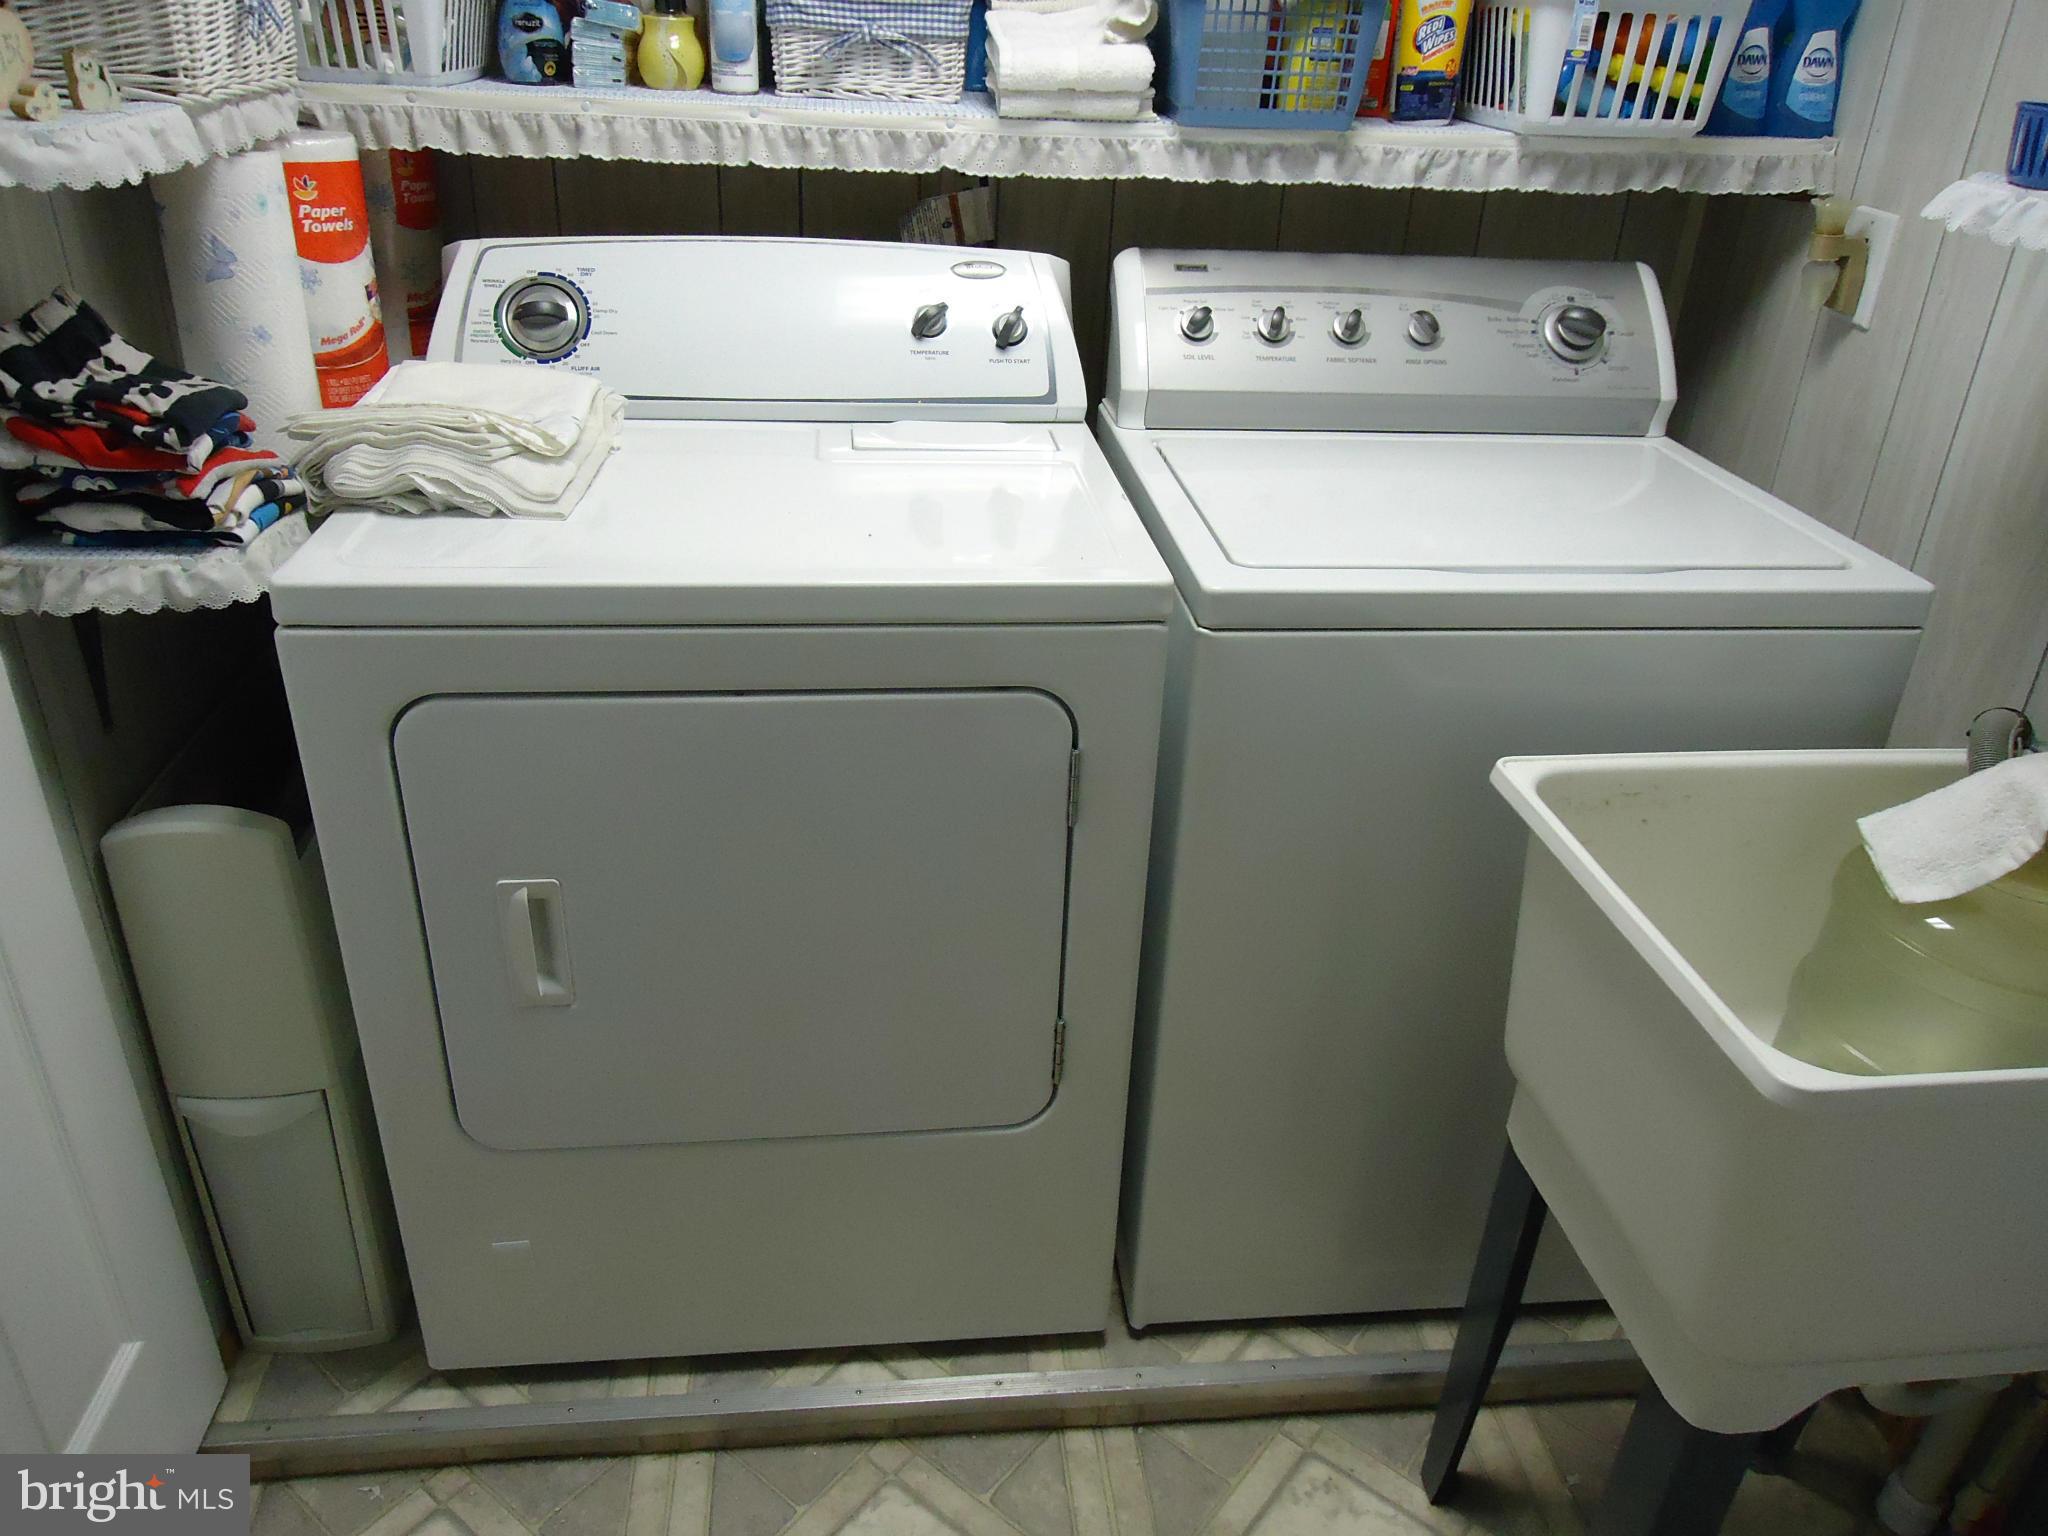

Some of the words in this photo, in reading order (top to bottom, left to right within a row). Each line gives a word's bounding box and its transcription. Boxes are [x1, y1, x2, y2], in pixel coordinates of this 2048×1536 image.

[514, 19, 541, 27] renuzit
[1418, 16, 1445, 41] REDI
[1422, 30, 1456, 54] WIPES
[1737, 54, 1768, 66] DAWN
[1803, 56, 1834, 68] DAWN
[298, 204, 347, 221] Paper
[301, 217, 354, 233] Towels
[320, 331, 349, 346] Mega
